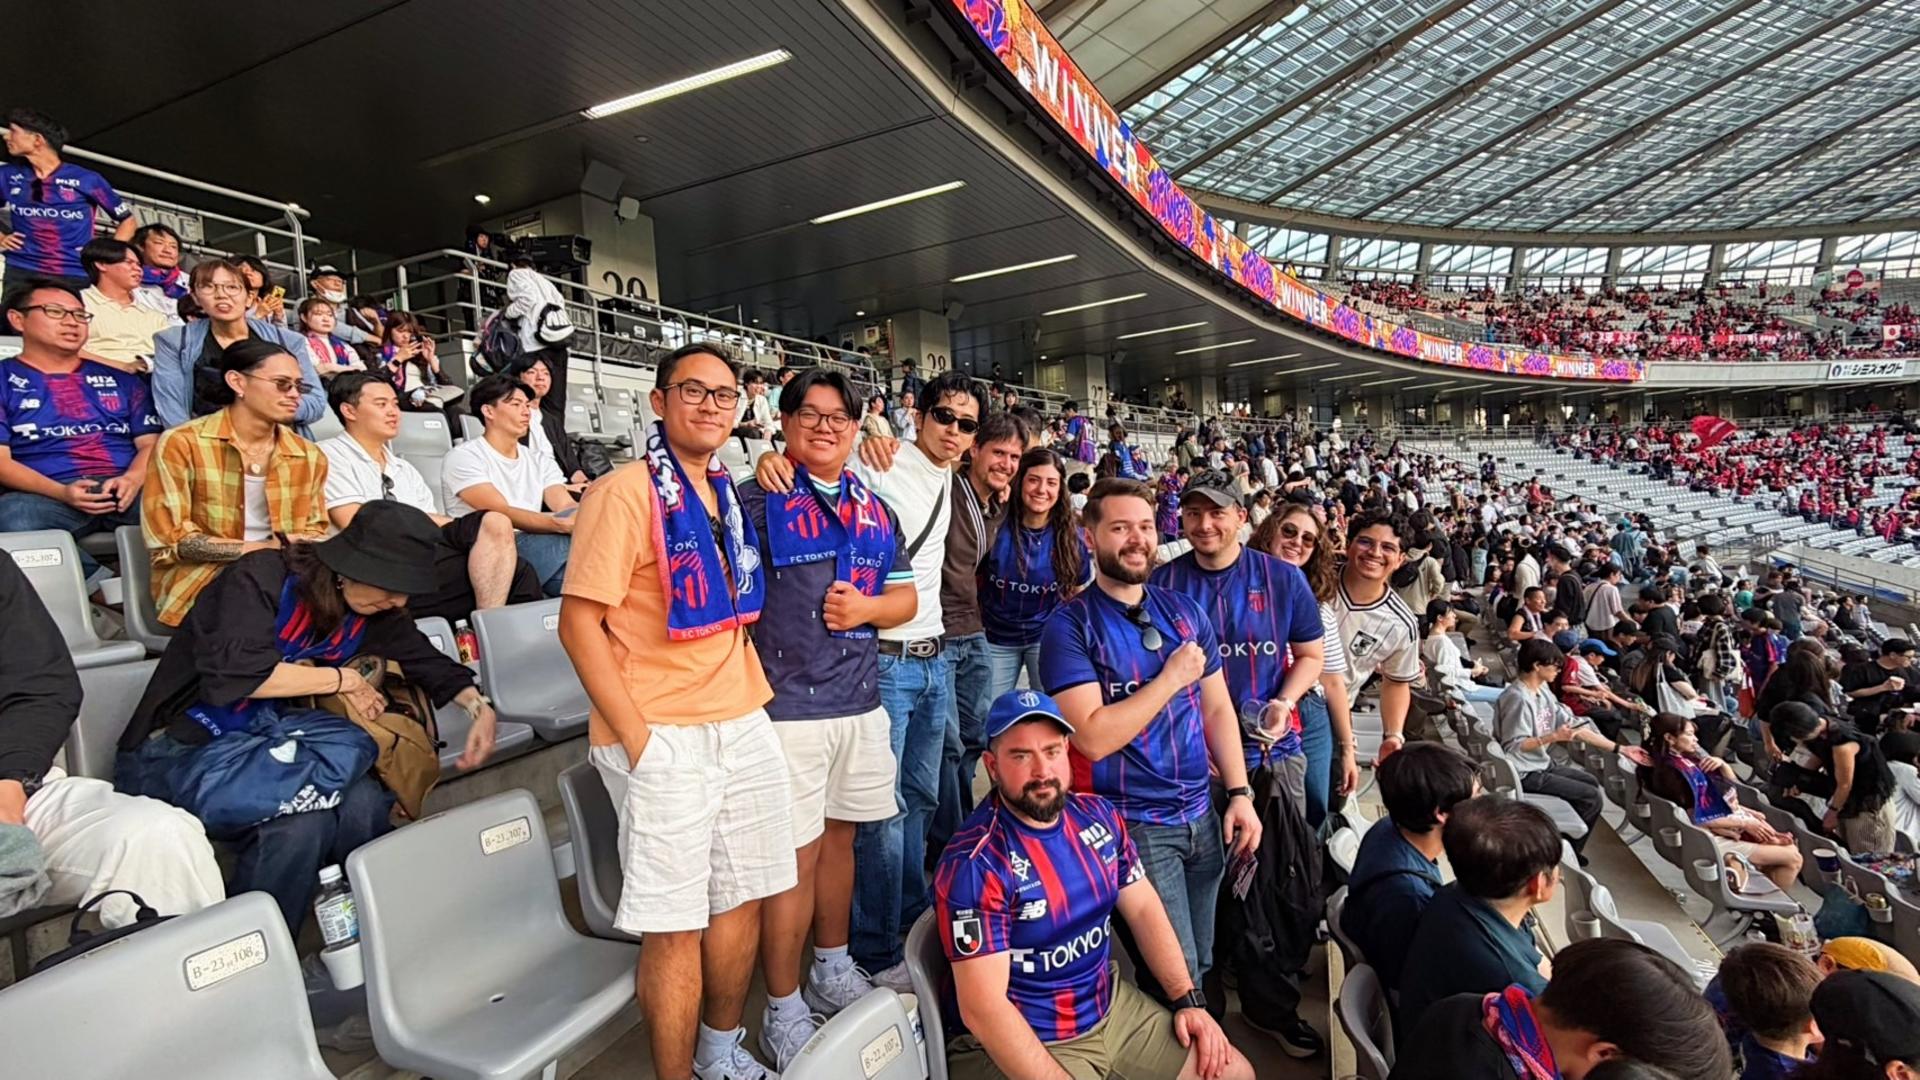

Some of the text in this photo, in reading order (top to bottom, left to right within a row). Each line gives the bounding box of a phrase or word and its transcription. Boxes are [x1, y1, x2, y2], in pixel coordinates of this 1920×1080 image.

[1031, 30, 1140, 192] WINNER
[18, 207, 84, 219] TOKYO GAS
[1280, 279, 1328, 325] WINNER
[1423, 339, 1463, 362] WINNER
[1557, 360, 1596, 376] WINNER
[41, 424, 101, 437] TOKYO
[790, 550, 837, 564] FC TOKYO
[681, 624, 723, 639] FC TOKYO
[1110, 680, 1139, 698] FC
[195, 712, 210, 725] FC
[1039, 926, 1103, 972] TOKYO
